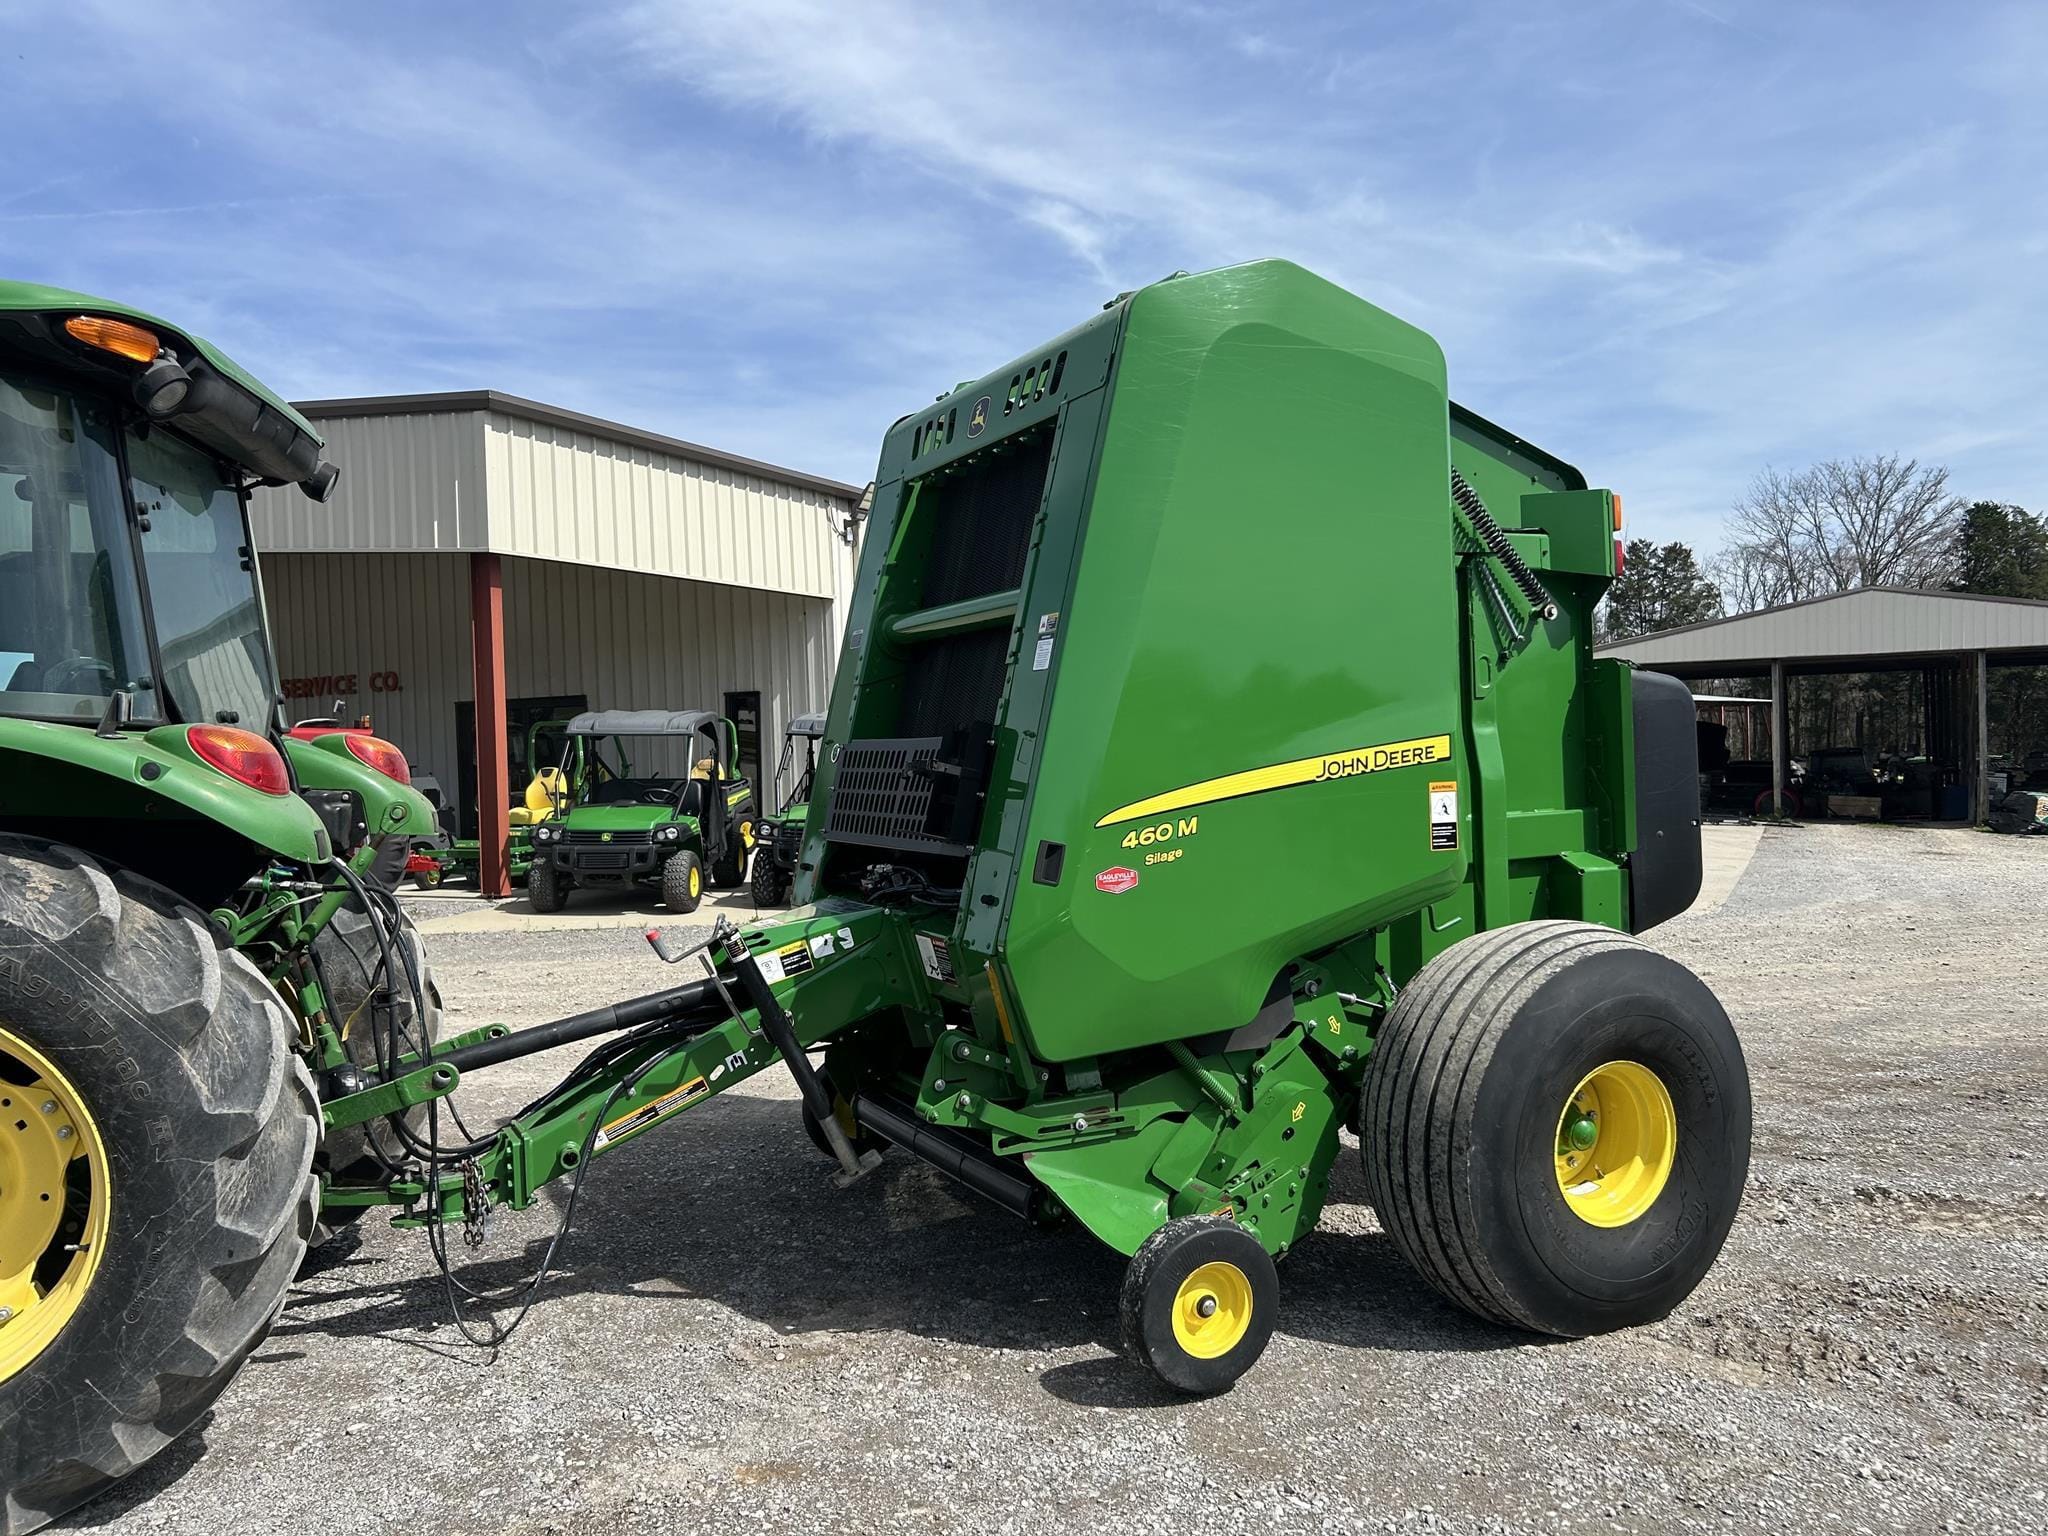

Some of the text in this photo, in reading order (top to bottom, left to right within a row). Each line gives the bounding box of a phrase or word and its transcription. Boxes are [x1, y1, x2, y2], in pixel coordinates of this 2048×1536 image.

[281, 671, 403, 699] SERVICE CO.
[1315, 745, 1436, 779] JOHN DEERE
[1121, 815, 1198, 849] 460 M
[1144, 848, 1183, 866] Silage
